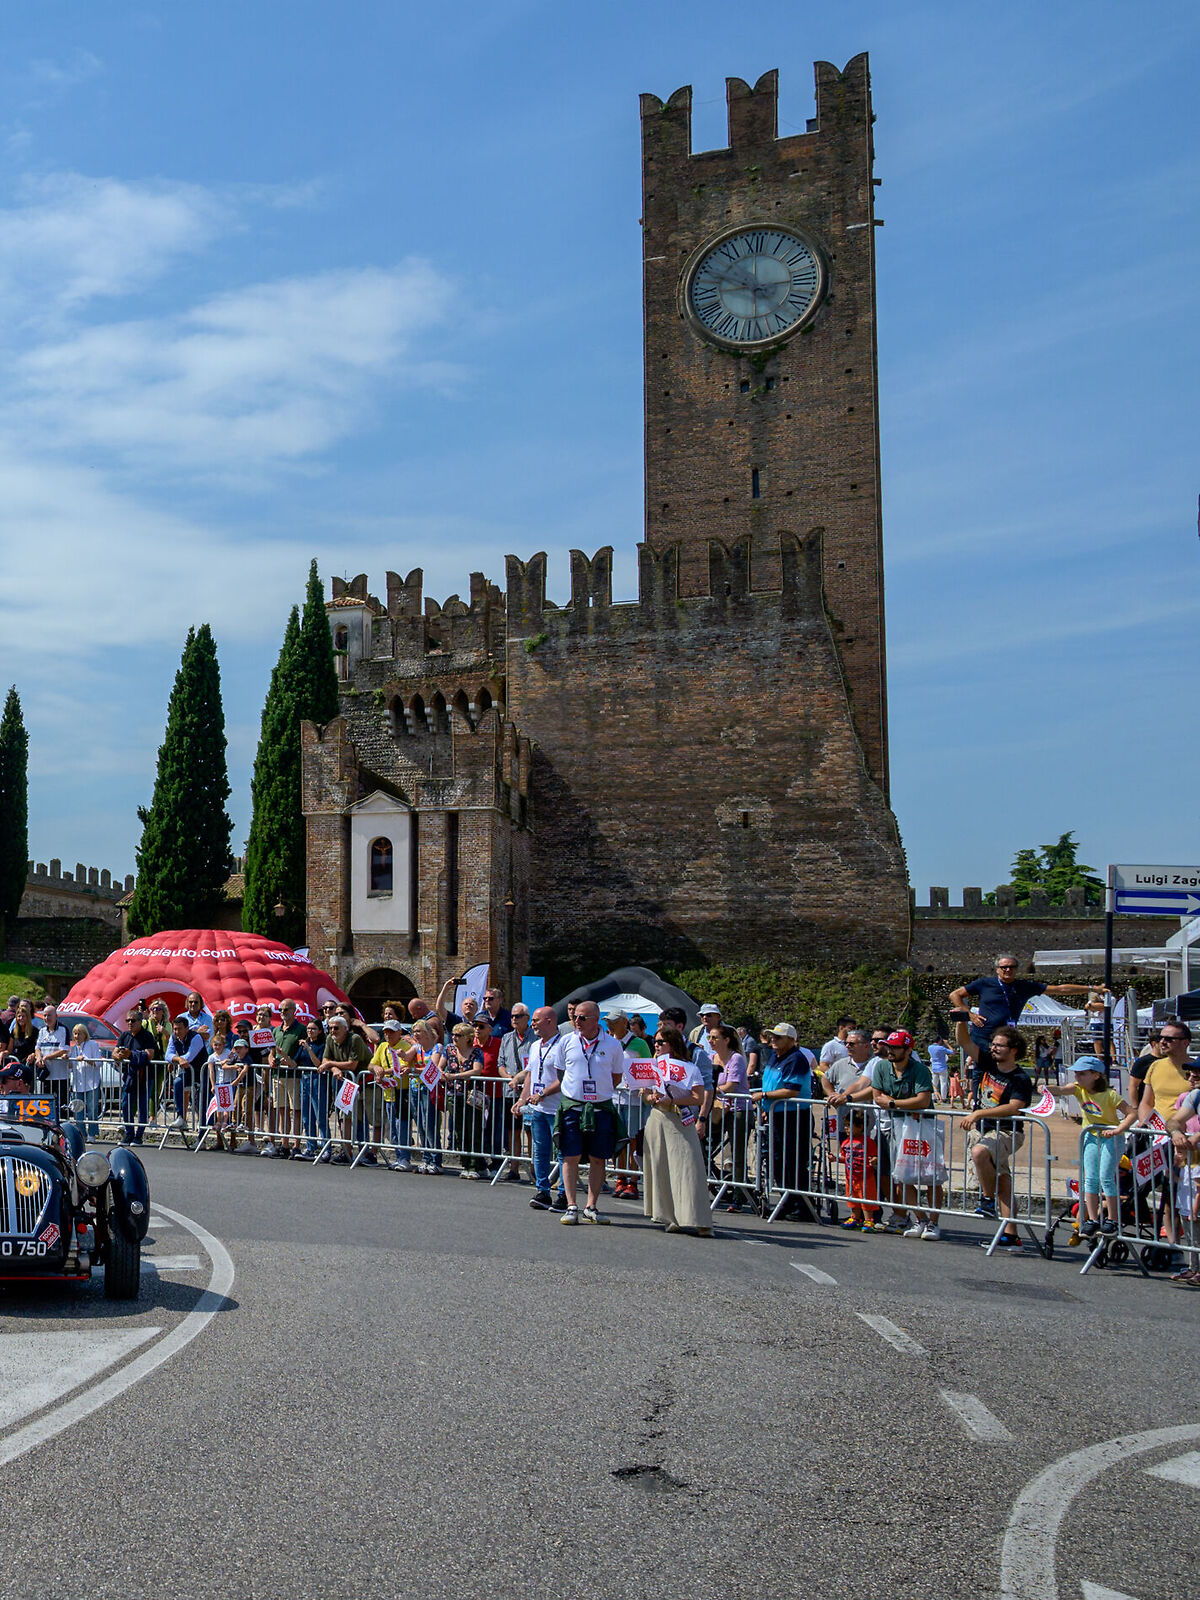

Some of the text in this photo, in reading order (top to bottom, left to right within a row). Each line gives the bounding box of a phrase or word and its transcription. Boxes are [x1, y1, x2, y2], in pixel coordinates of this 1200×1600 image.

[744, 235, 764, 253] XII
[720, 243, 740, 261] XI
[793, 271, 812, 286] III
[1135, 875, 1200, 886] Luigi Zag
[123, 948, 236, 958] tomasiauto.com
[227, 1000, 316, 1017] tomsi
[16, 1100, 50, 1116] 165
[1142, 1151, 1159, 1166] 100
[42, 1227, 54, 1240] 1000
[17, 1241, 47, 1256] 750
